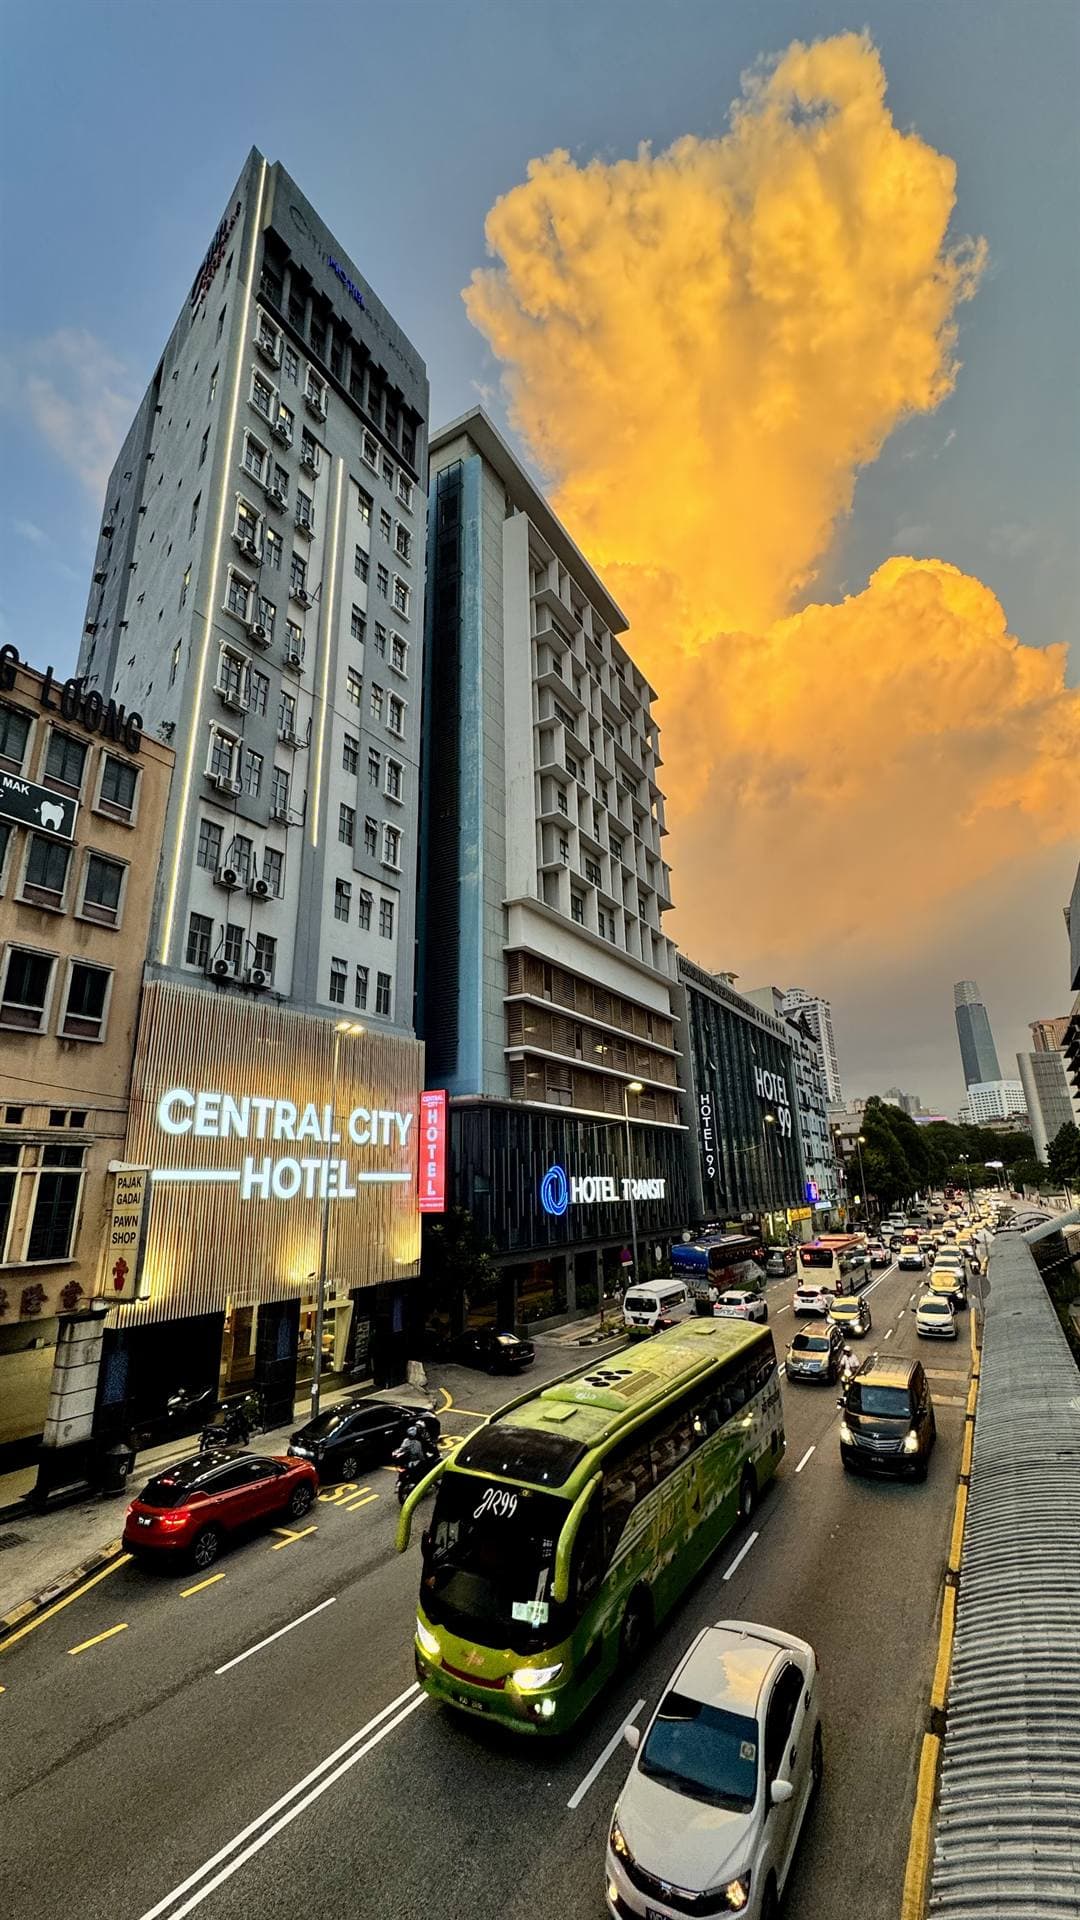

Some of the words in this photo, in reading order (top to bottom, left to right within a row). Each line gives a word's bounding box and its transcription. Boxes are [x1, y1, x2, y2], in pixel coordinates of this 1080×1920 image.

[41, 665, 143, 754] LOONG
[2, 777, 31, 796] MAK
[754, 1066, 790, 1106] HOTEL
[157, 1087, 341, 1144] CENTRAL
[348, 1107, 413, 1147] CITY
[700, 1094, 714, 1151] HOTEL
[777, 1106, 792, 1138] 99
[426, 1108, 438, 1197] HOTEL
[706, 1154, 716, 1179] 99
[117, 1176, 142, 1189] PAJAK
[241, 1157, 357, 1200] HOTEL
[570, 1176, 620, 1203] HOTEL
[621, 1178, 666, 1201] TRANSIT
[116, 1192, 141, 1205] GADAI
[113, 1215, 138, 1228] PAWN
[112, 1232, 136, 1244] SHOP
[473, 1488, 518, 1519] JR99
